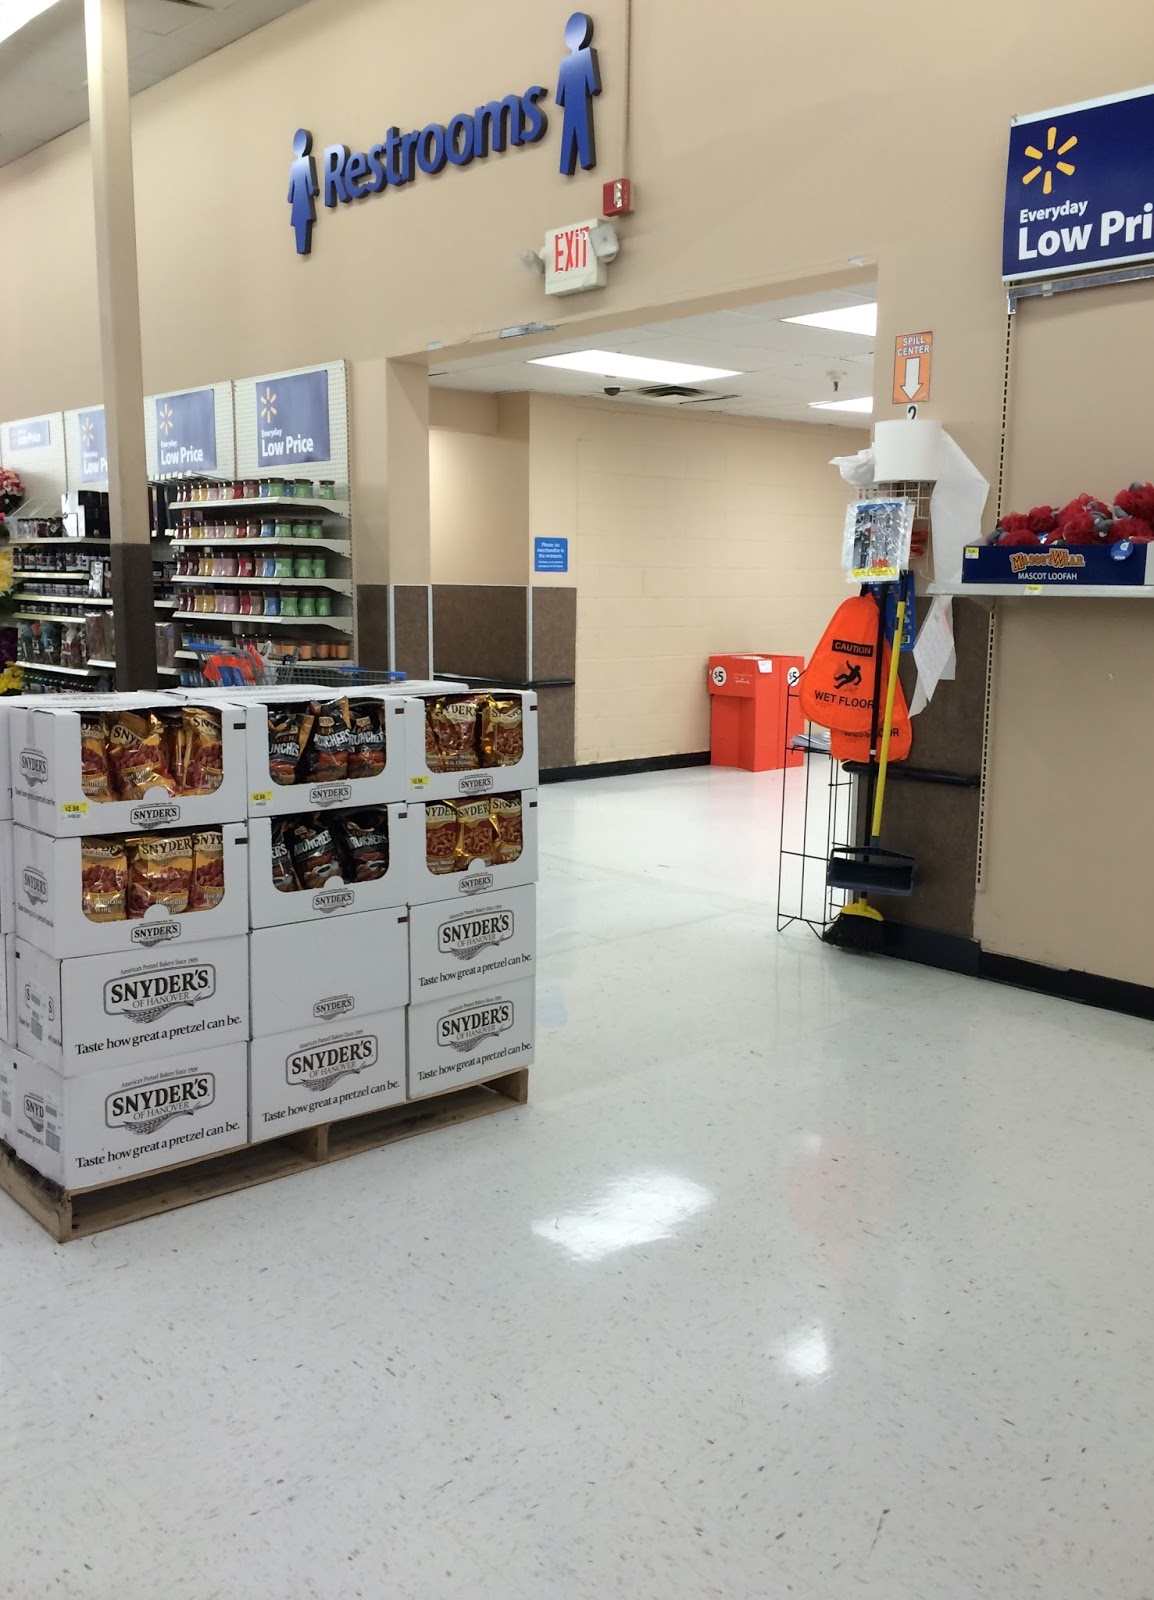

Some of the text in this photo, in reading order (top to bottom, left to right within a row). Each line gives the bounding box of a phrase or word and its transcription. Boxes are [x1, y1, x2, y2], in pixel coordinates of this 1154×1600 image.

[324, 86, 548, 207] Restrooms
[1019, 200, 1088, 224] Everyday
[1018, 203, 1154, 260] Low Pri
[555, 227, 590, 273] EXIT
[902, 335, 925, 346] SPILL
[897, 345, 930, 356] CENTER
[261, 427, 283, 438] Everyday
[160, 440, 177, 448] Everyday
[261, 433, 314, 457] Low Price
[160, 445, 204, 466] Low Price
[83, 461, 100, 474] Low
[1018, 572, 1077, 580] MASCOT LOOFAH
[834, 641, 871, 655] CAUTION
[714, 671, 724, 682] $5
[814, 690, 873, 709] WET FLOOR
[22, 755, 46, 774] SNYDER'S
[461, 777, 491, 789] SNYDER'S
[312, 787, 349, 799] SNYDER'S
[133, 807, 177, 820] SNYDER'S
[25, 873, 46, 895] SNYDER'S
[461, 876, 491, 888] SNYDER'S
[315, 893, 352, 906] SNYDER'S
[134, 924, 178, 939] SNYDER'S
[443, 914, 509, 943] SNYDER'S
[467, 934, 496, 946] HANOVER
[418, 953, 532, 987] Taste how great a pretzel can be.
[111, 969, 208, 1003] SNYDER'S
[133, 992, 189, 1008] OF HANOVER
[316, 998, 352, 1013] SNYDER'S
[442, 1005, 509, 1037] SNYDER'S
[75, 1042, 104, 1055] Taste
[107, 1036, 131, 1048] how
[132, 1031, 160, 1046] great
[169, 1020, 205, 1039] pretzel
[207, 1020, 225, 1030] can
[227, 1015, 242, 1025] be.
[466, 1025, 495, 1038] HANOVER
[292, 1040, 372, 1074] SNYDER'S
[417, 1070, 437, 1081] Taste
[439, 1065, 456, 1076] how
[456, 1058, 476, 1072] great
[482, 1048, 507, 1065] pretzel
[508, 1046, 520, 1055] can
[522, 1042, 532, 1050] be.
[310, 1061, 356, 1078] OF HANOVER
[112, 1078, 208, 1117] SNYDER'S
[262, 1110, 286, 1122] Taste
[288, 1104, 308, 1116] how
[309, 1098, 331, 1113] great
[339, 1085, 369, 1105] pretzel
[370, 1084, 386, 1094] can
[387, 1079, 400, 1089] be.
[133, 1101, 189, 1120] OF HANOVER
[75, 1155, 105, 1168] Taste
[107, 1150, 131, 1163] how
[132, 1141, 160, 1158] great
[169, 1128, 204, 1150] pretzel
[206, 1127, 224, 1137] can
[225, 1121, 240, 1132] be.
